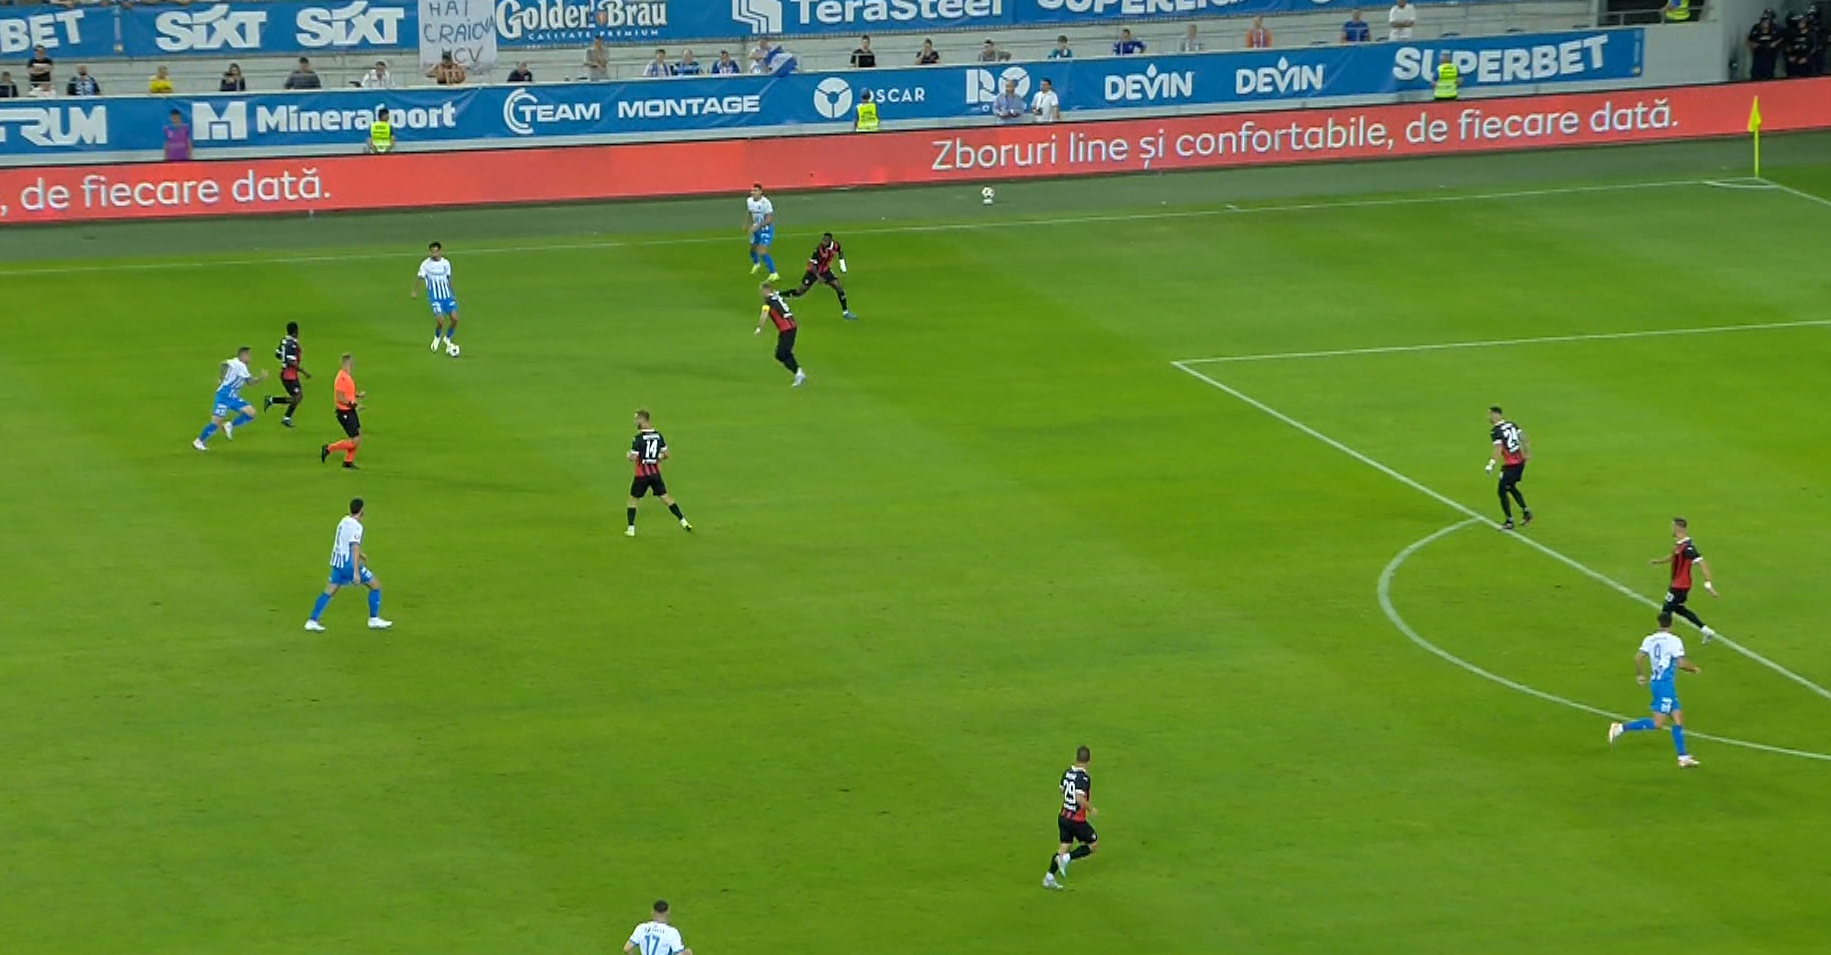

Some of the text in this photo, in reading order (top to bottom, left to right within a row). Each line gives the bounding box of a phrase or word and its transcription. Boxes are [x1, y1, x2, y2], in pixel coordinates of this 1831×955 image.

[429, 1, 468, 17] HAI
[791, 0, 1002, 25] TeraSteel
[155, 4, 267, 51] SIXT
[296, 1, 404, 47] SIXT
[1104, 70, 1193, 101] DEVIN
[1235, 64, 1324, 95] DEVIN
[618, 95, 760, 119] MONTAGE
[931, 98, 1680, 170] Zboruri line și confortabile, de fiecare dată.
[20, 177, 70, 211] de
[80, 174, 219, 209] fiecare
[231, 168, 331, 202] dată.
[644, 438, 659, 459] 14
[1062, 779, 1077, 805] 29
[644, 934, 661, 955] 17
